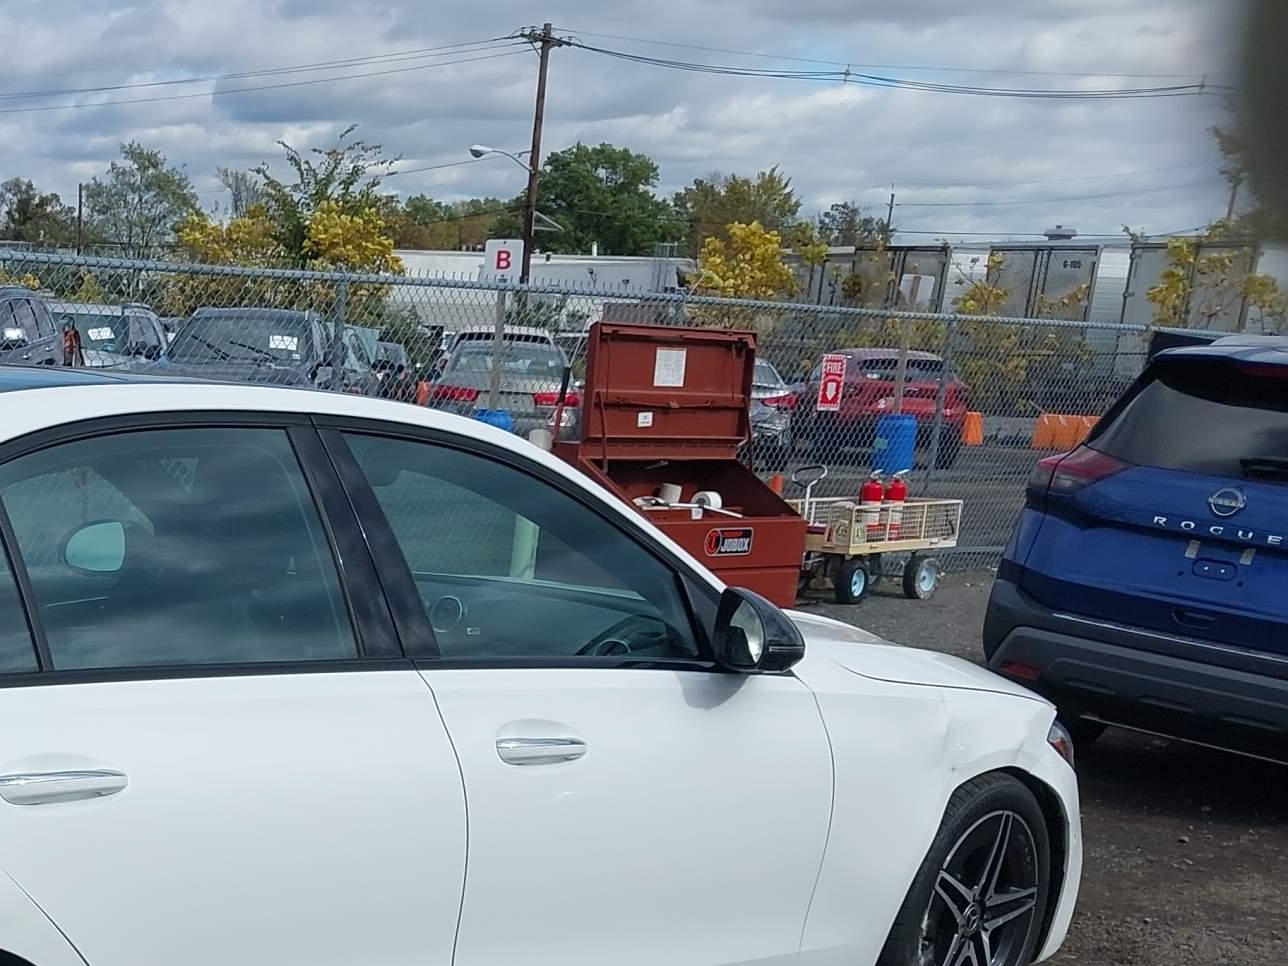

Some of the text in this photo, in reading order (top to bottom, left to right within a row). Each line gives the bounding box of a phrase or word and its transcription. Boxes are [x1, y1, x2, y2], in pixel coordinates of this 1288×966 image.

[496, 250, 511, 270] B
[826, 361, 843, 374] FIRE
[1153, 516, 1283, 545] ROGUE
